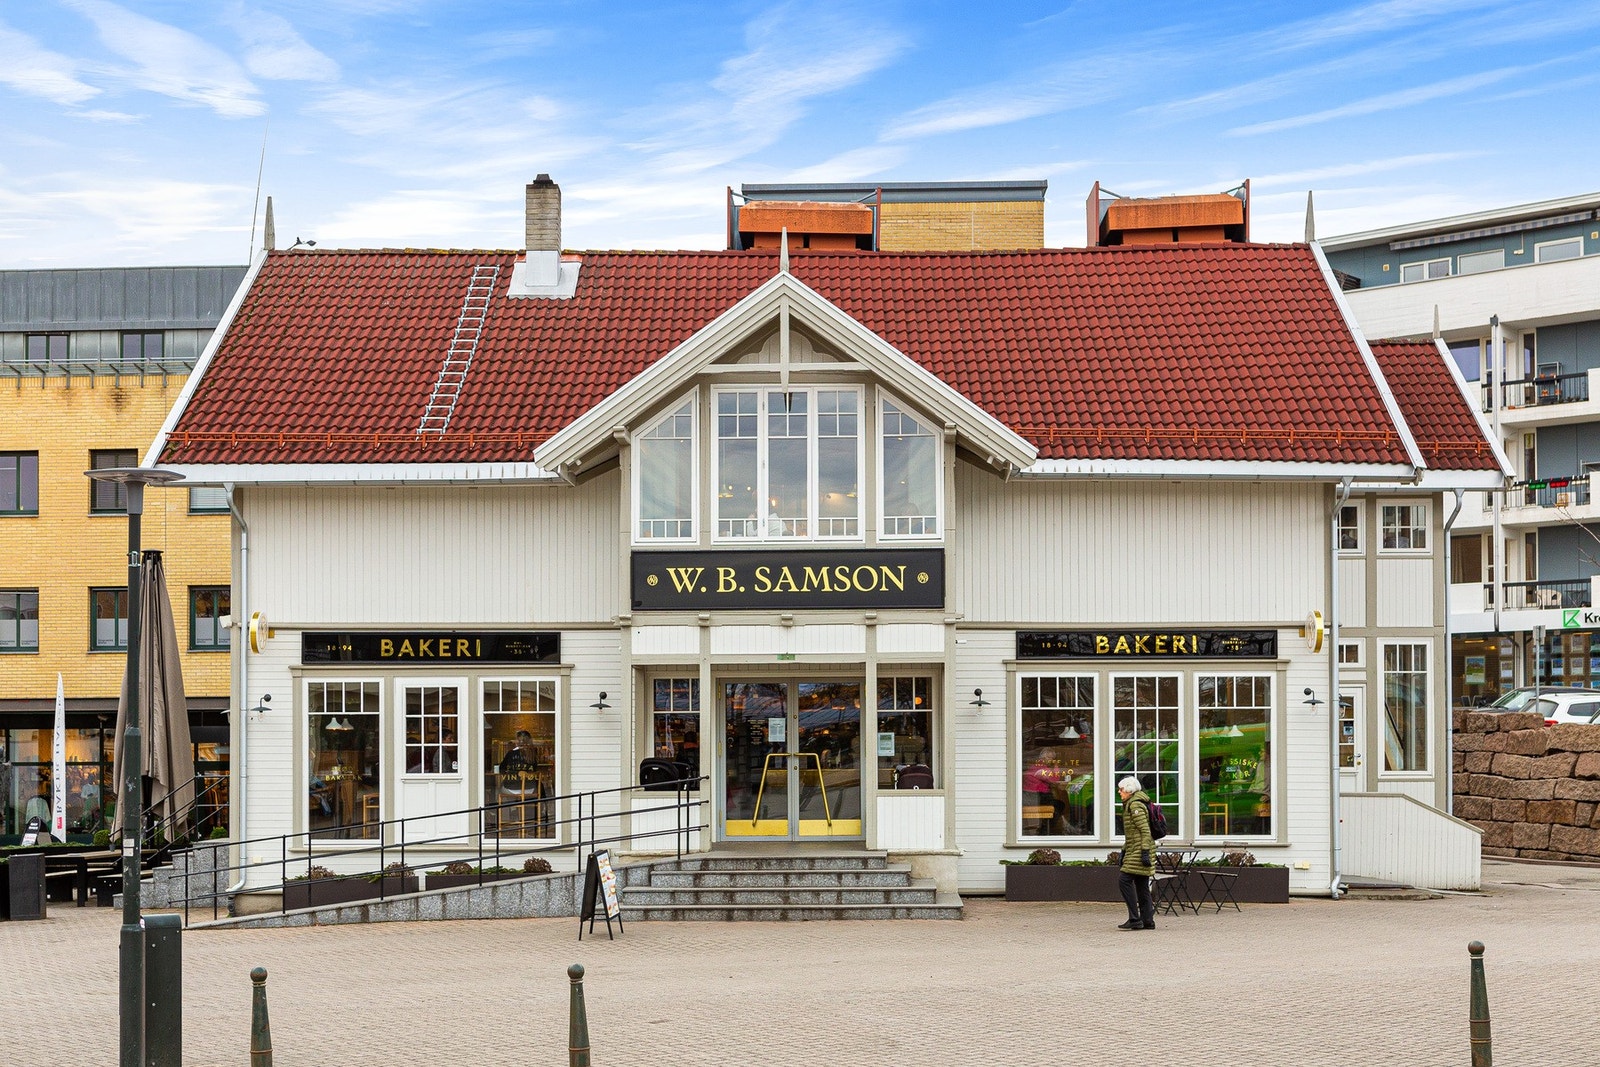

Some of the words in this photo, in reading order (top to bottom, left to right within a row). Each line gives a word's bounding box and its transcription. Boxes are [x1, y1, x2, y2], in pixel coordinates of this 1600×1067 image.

[666, 567, 706, 593] W.
[716, 567, 745, 592] B.
[754, 565, 907, 592] SAMSON
[380, 638, 481, 657] BAKERI
[1095, 634, 1198, 654] BAKERI
[1041, 768, 1075, 777] KAKAO
[1210, 758, 1258, 770] KLASSISKE
